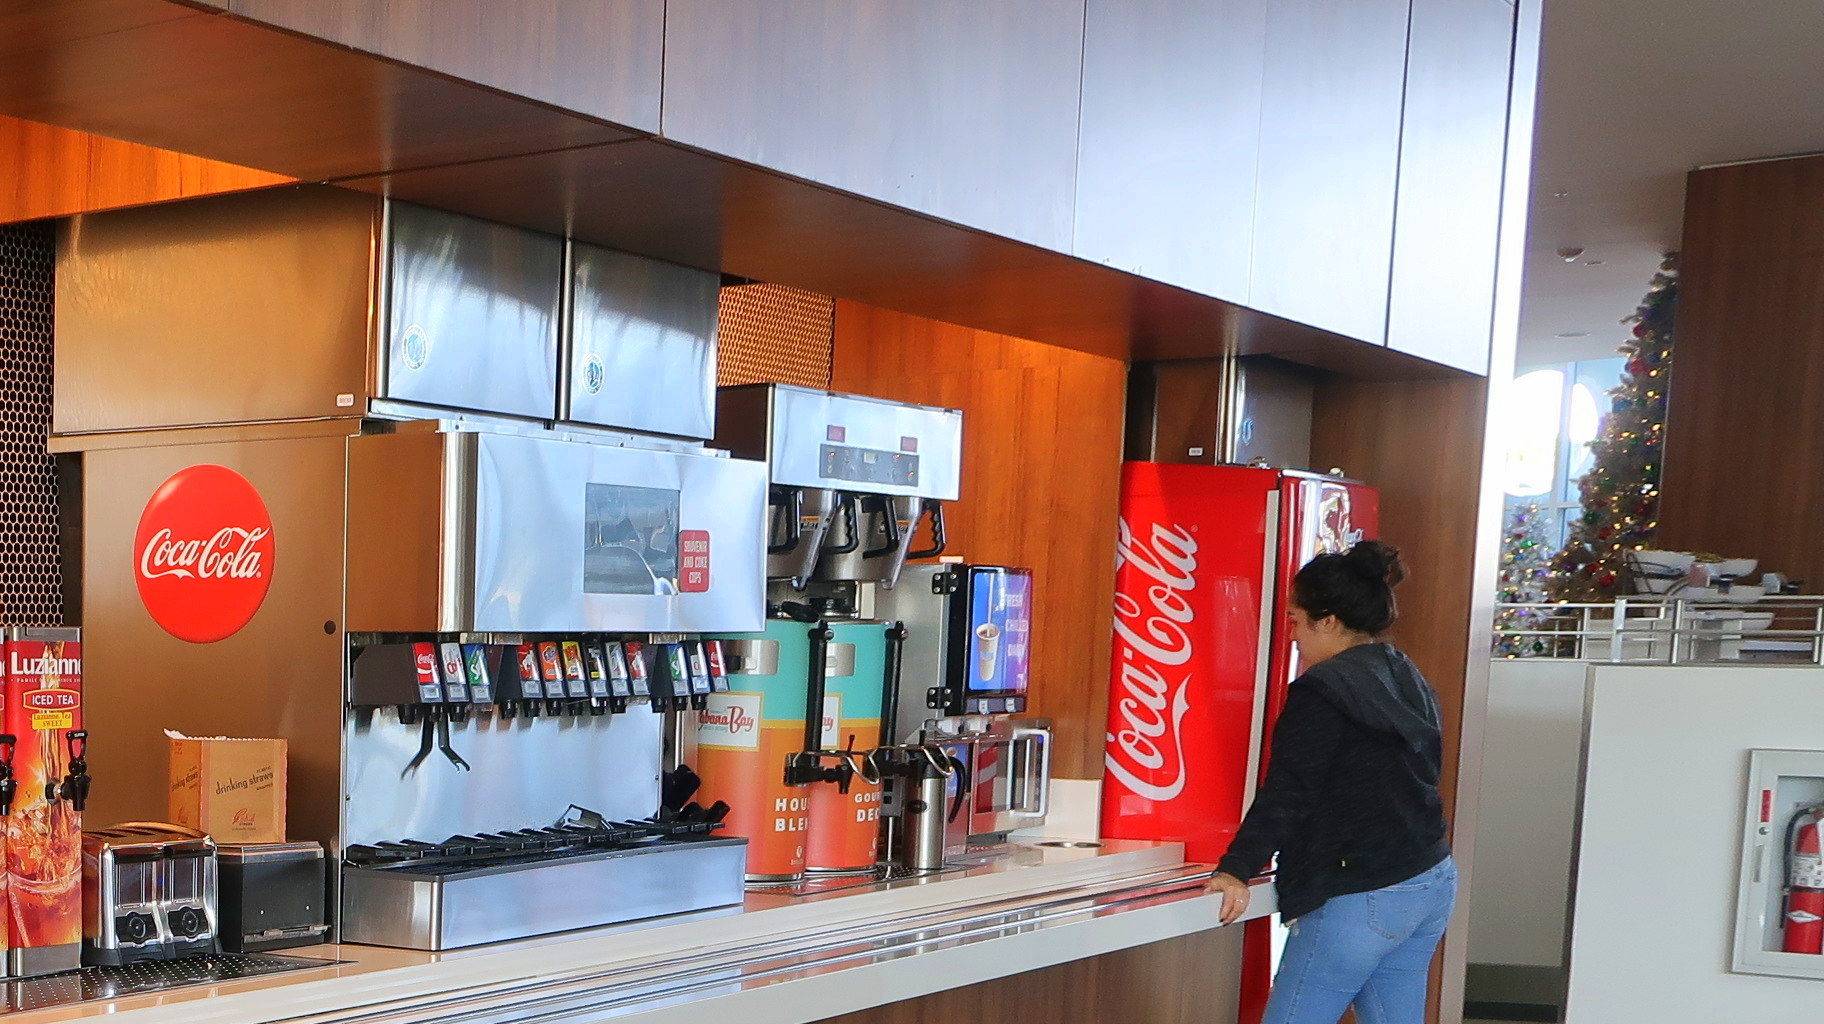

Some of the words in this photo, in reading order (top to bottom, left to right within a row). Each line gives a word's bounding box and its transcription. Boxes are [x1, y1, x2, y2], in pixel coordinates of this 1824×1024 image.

[140, 526, 271, 579] Coca-Cola
[1105, 515, 1200, 802] Coca-Cola
[32, 695, 53, 705] ICED
[57, 695, 74, 705] TEA
[727, 705, 754, 734] Bay
[215, 777, 249, 796] drinking
[249, 772, 274, 785] straws
[775, 798, 808, 812] HOU
[775, 818, 808, 832] BLE
[856, 809, 879, 822] DEC
